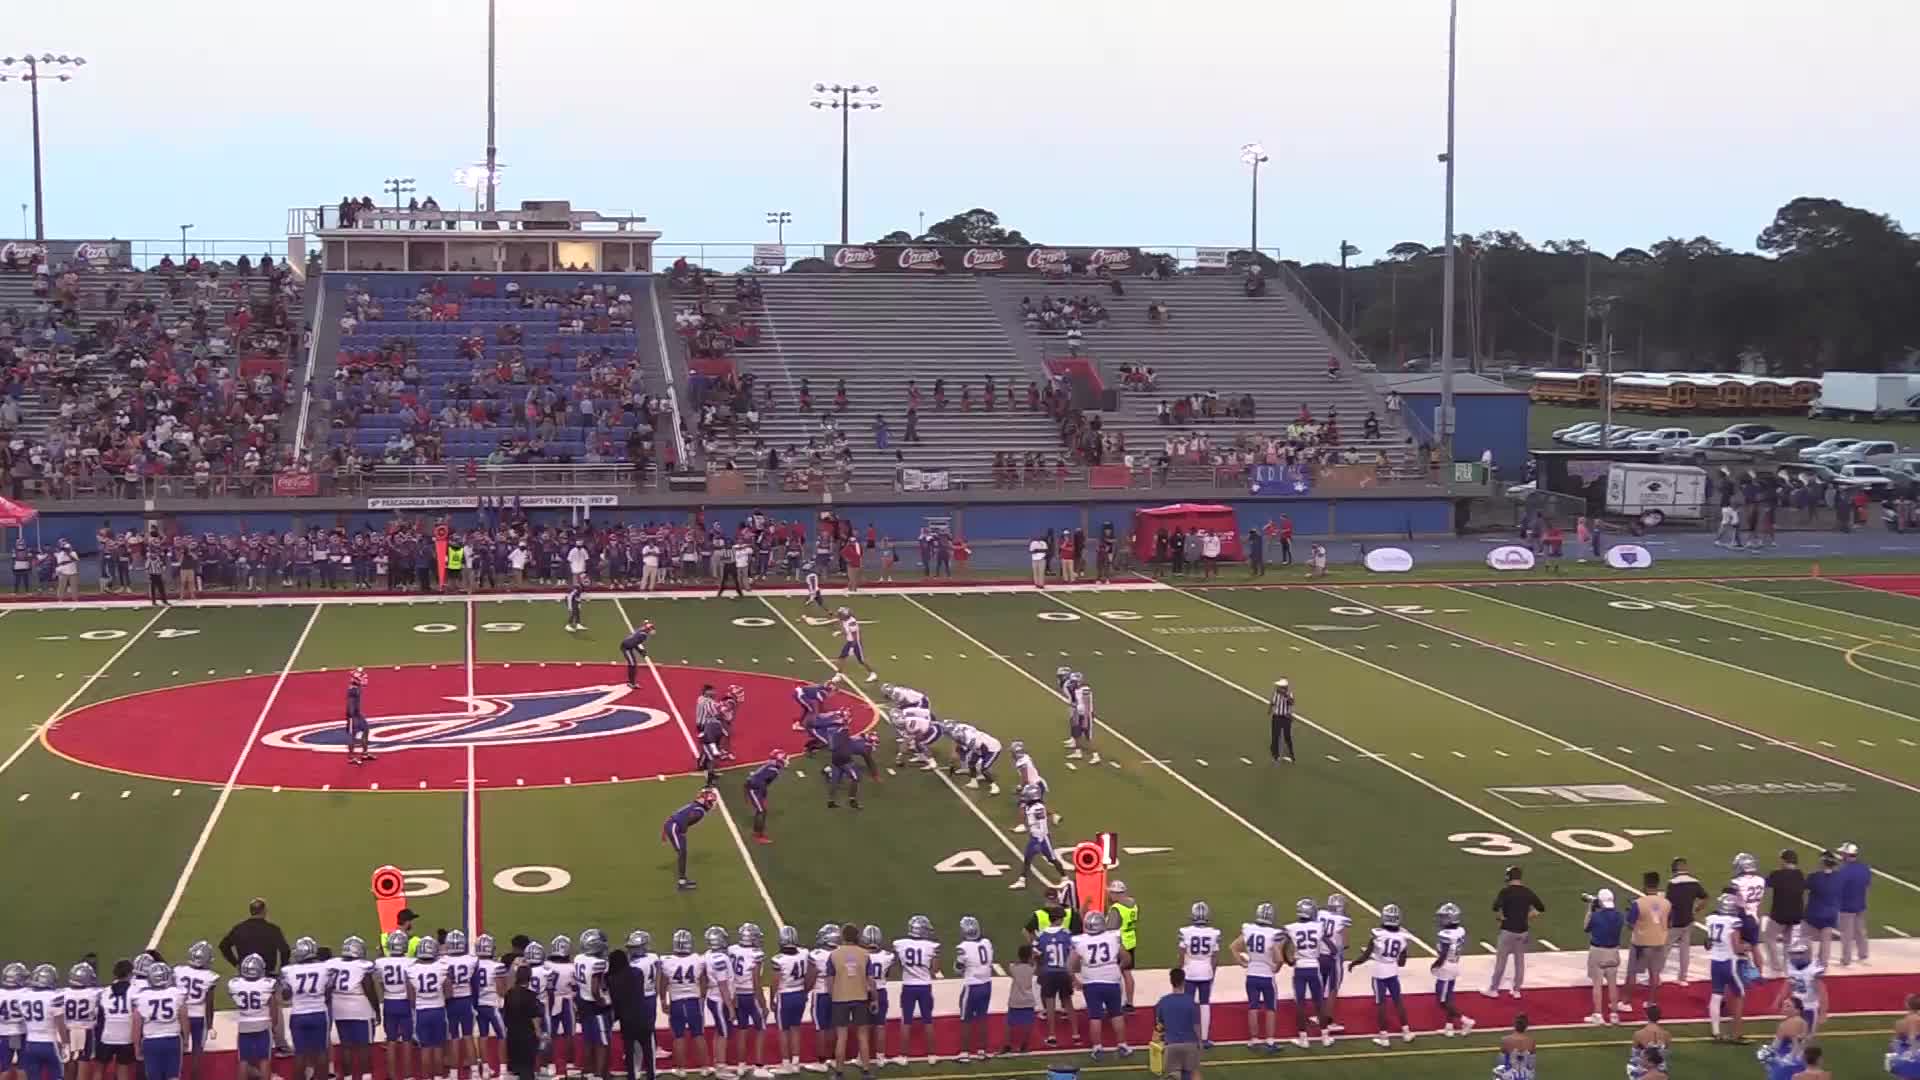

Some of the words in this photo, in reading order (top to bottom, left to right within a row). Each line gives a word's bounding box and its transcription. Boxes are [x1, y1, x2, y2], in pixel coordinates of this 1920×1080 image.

[834, 248, 876, 268] Cane's
[898, 248, 942, 268] Cane's
[964, 248, 1006, 268] Cane's
[1747, 886, 1765, 903] 22
[1190, 936, 1211, 955] 85
[1247, 933, 1265, 954] 48
[1296, 930, 1318, 950] 25
[1384, 939, 1400, 958] 18
[904, 948, 923, 967] 91
[1088, 942, 1110, 964] 73
[384, 965, 404, 985] 21
[672, 965, 696, 984] 44
[790, 960, 805, 981] 41
[295, 972, 319, 994] 77
[417, 973, 438, 993] 12
[22, 1000, 45, 1021] 39
[65, 999, 89, 1020] 82
[149, 998, 174, 1021] 75
[238, 991, 261, 1010] 36
